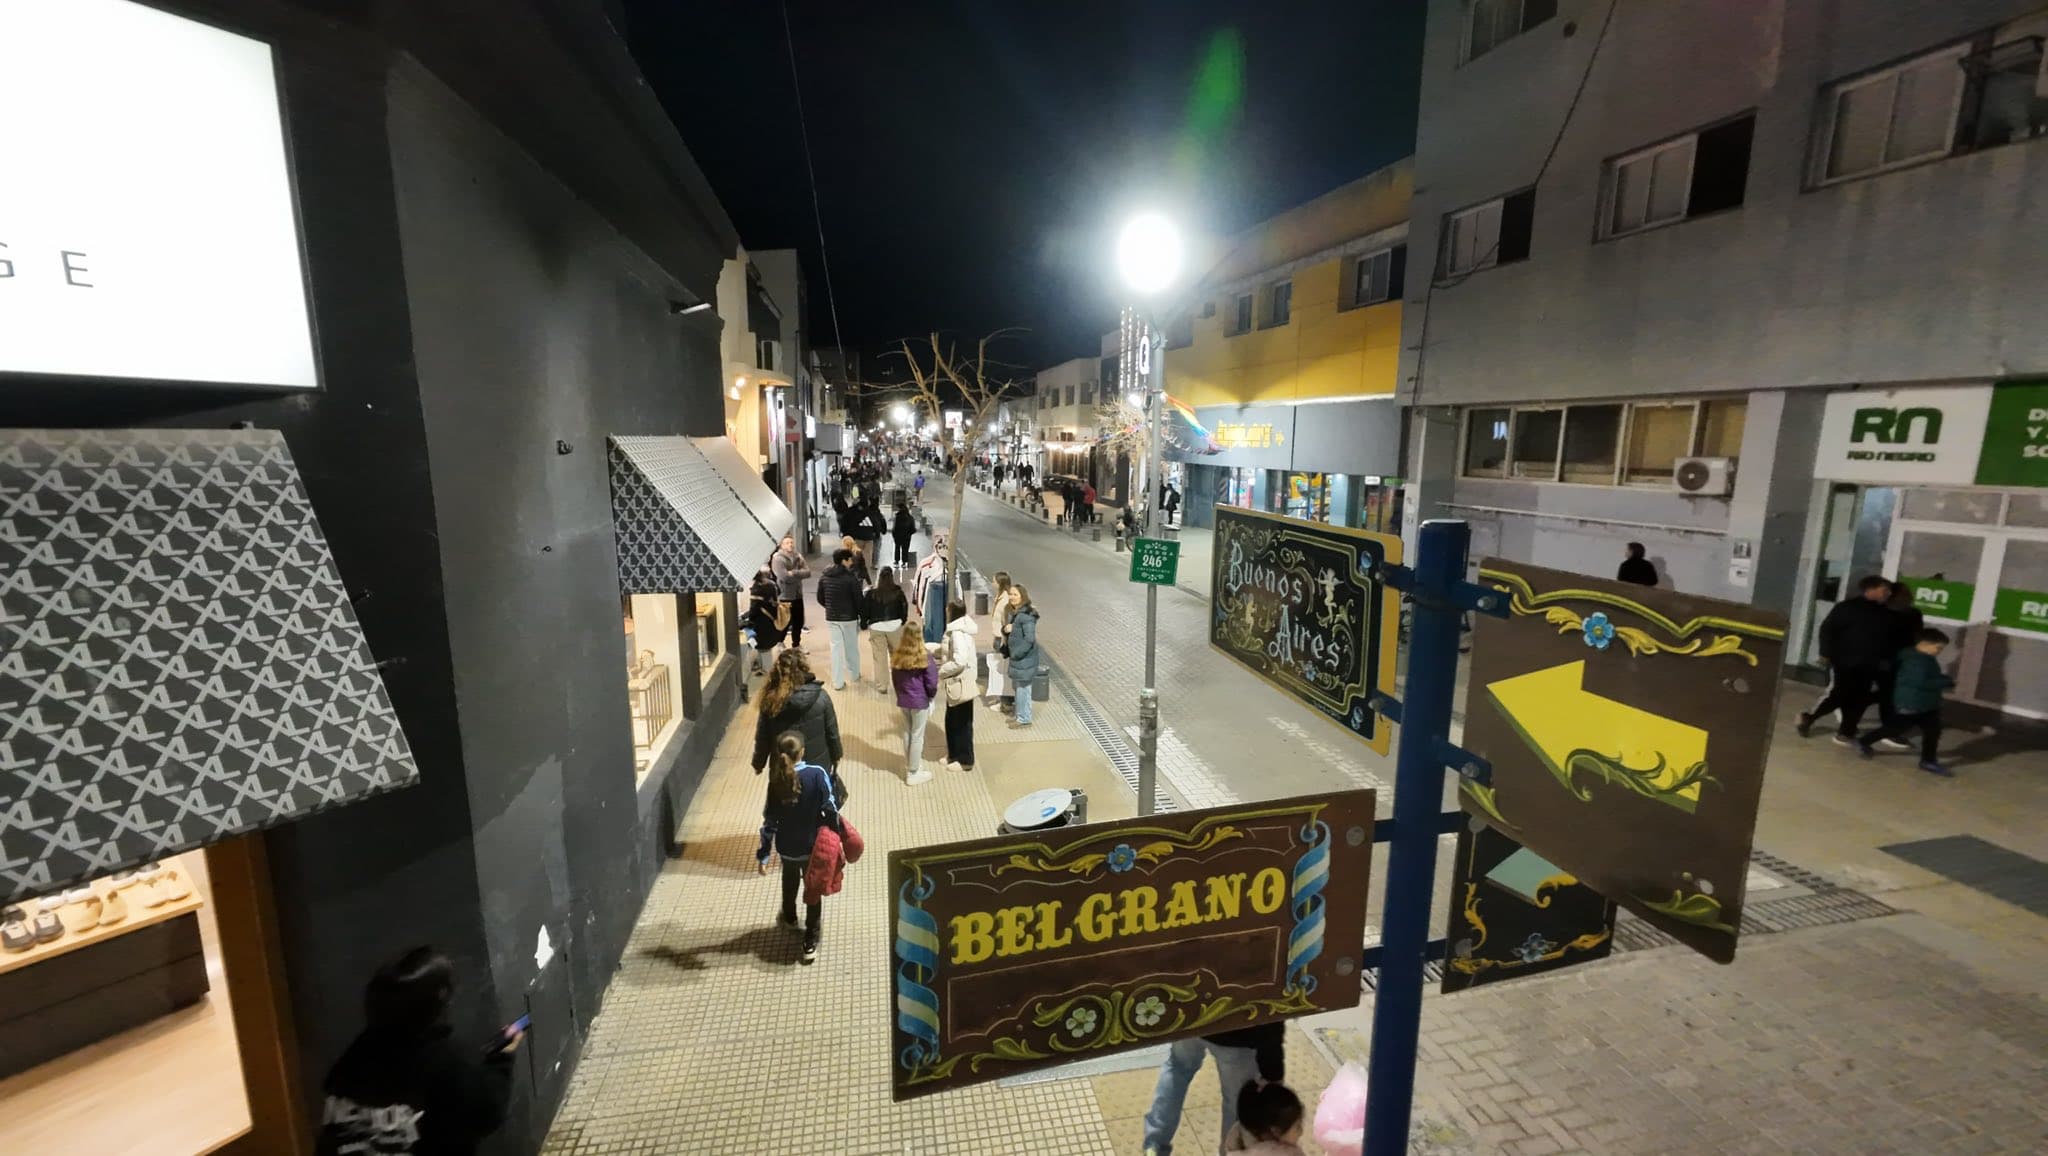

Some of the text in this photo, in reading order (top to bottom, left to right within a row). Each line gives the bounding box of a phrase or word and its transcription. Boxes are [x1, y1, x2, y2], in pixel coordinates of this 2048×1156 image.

[2028, 408, 2048, 421] D
[1226, 540, 1304, 604] Buenos
[1268, 604, 1341, 669] Aires
[950, 867, 1287, 967] BELGRANO
